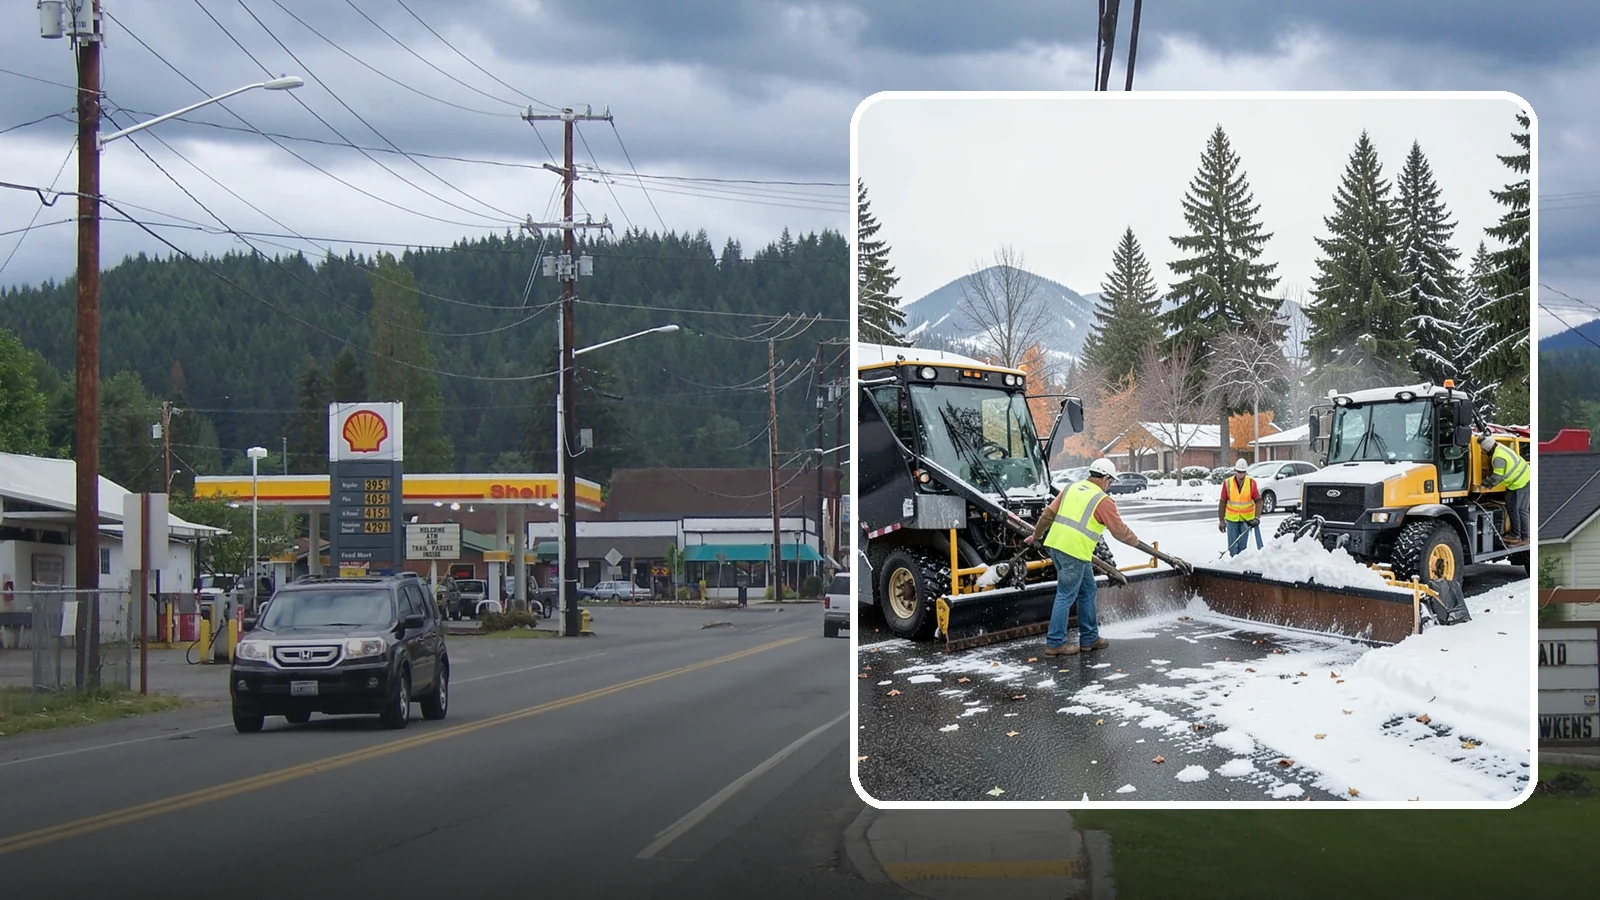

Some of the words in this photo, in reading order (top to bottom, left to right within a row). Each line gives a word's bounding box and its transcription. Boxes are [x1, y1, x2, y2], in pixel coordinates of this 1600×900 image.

[366, 480, 383, 490] 395
[490, 484, 547, 499] Shell
[365, 494, 383, 504] 405
[365, 508, 383, 518] 415
[365, 522, 383, 532] 429
